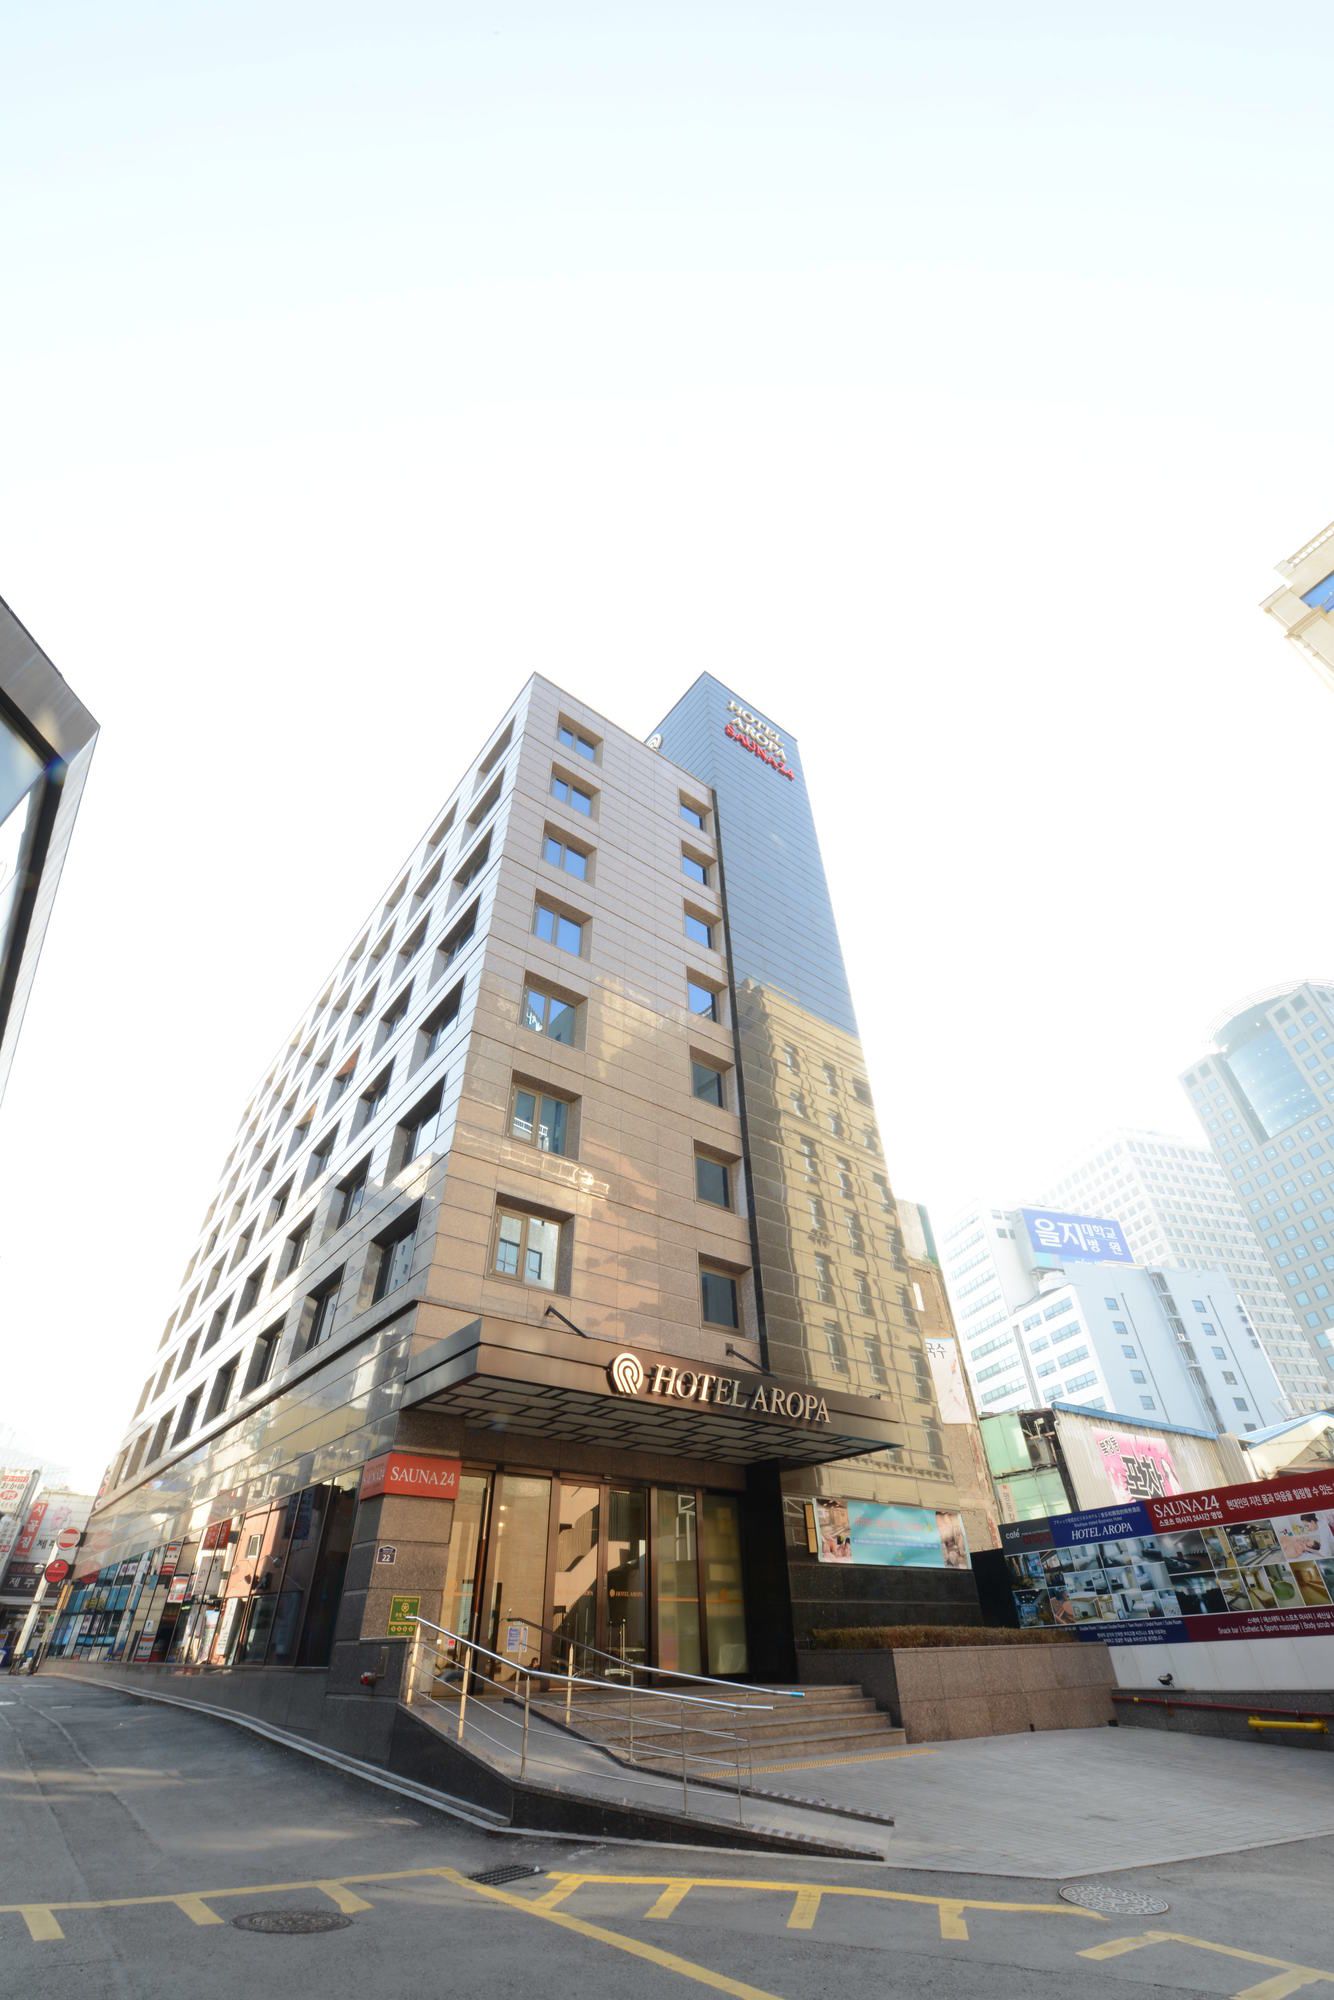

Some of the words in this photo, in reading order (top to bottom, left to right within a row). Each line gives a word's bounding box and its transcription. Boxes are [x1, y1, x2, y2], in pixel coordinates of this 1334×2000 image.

[726, 700, 784, 747] HOTEL
[731, 717, 787, 762] AROPA
[1034, 1218, 1089, 1251] 을지
[1080, 1223, 1118, 1239] 대학교
[651, 1363, 748, 1408] HOTEL
[751, 1384, 832, 1424] AROPA
[390, 1466, 438, 1485] SAUNA
[440, 1471, 455, 1486] 24
[1312, 1486, 1319, 1496] 수
[1153, 1499, 1202, 1518] SAUNA
[1201, 1495, 1220, 1511] 24
[1071, 1527, 1101, 1540] HOTEL
[1102, 1522, 1133, 1535] AROPA
[382, 1554, 391, 1562] 22
